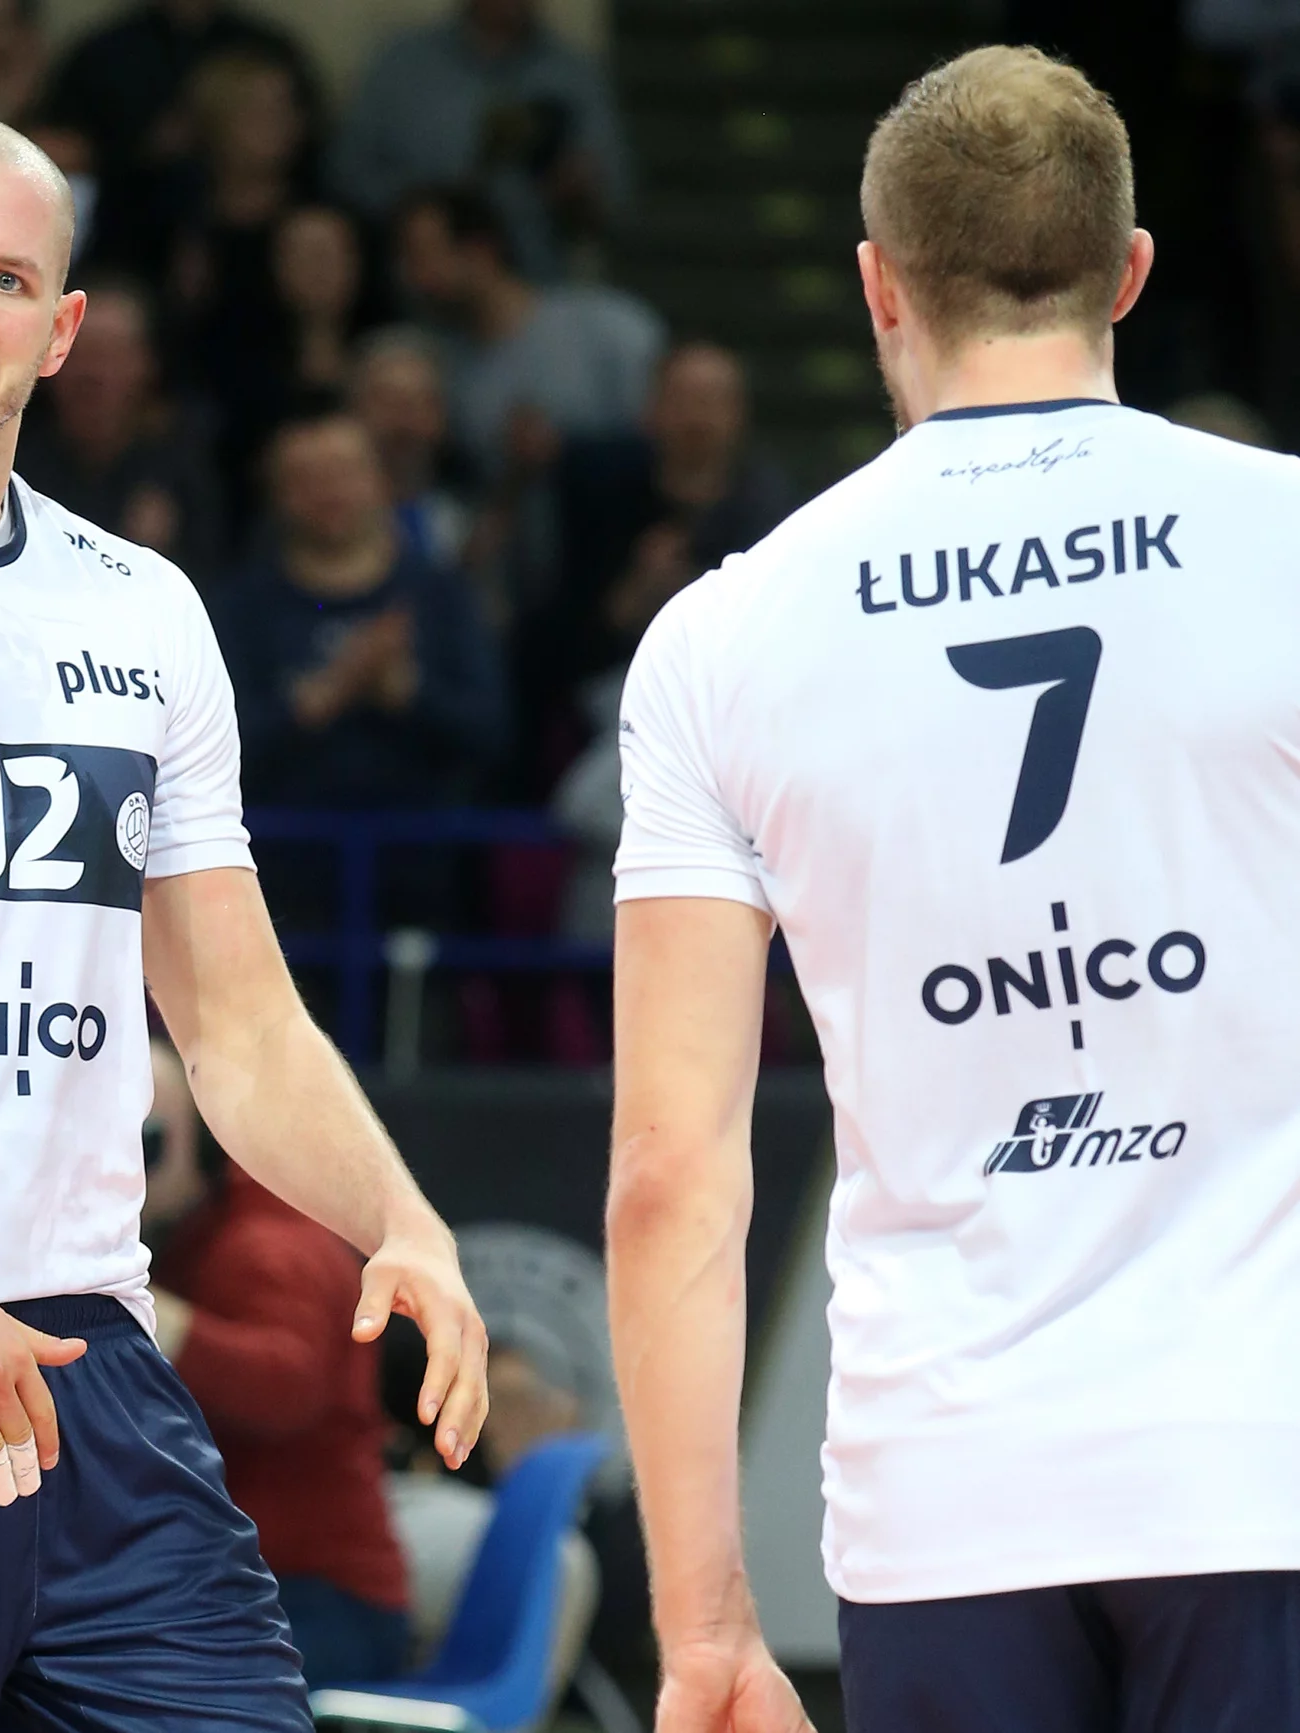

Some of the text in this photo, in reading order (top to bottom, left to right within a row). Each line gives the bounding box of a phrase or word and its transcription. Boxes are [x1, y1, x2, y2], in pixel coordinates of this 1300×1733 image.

[855, 514, 1182, 614] ŁUKASIK
[946, 626, 1103, 864] 7
[921, 901, 1207, 1050] ONICO
[1069, 1121, 1188, 1168] mza
